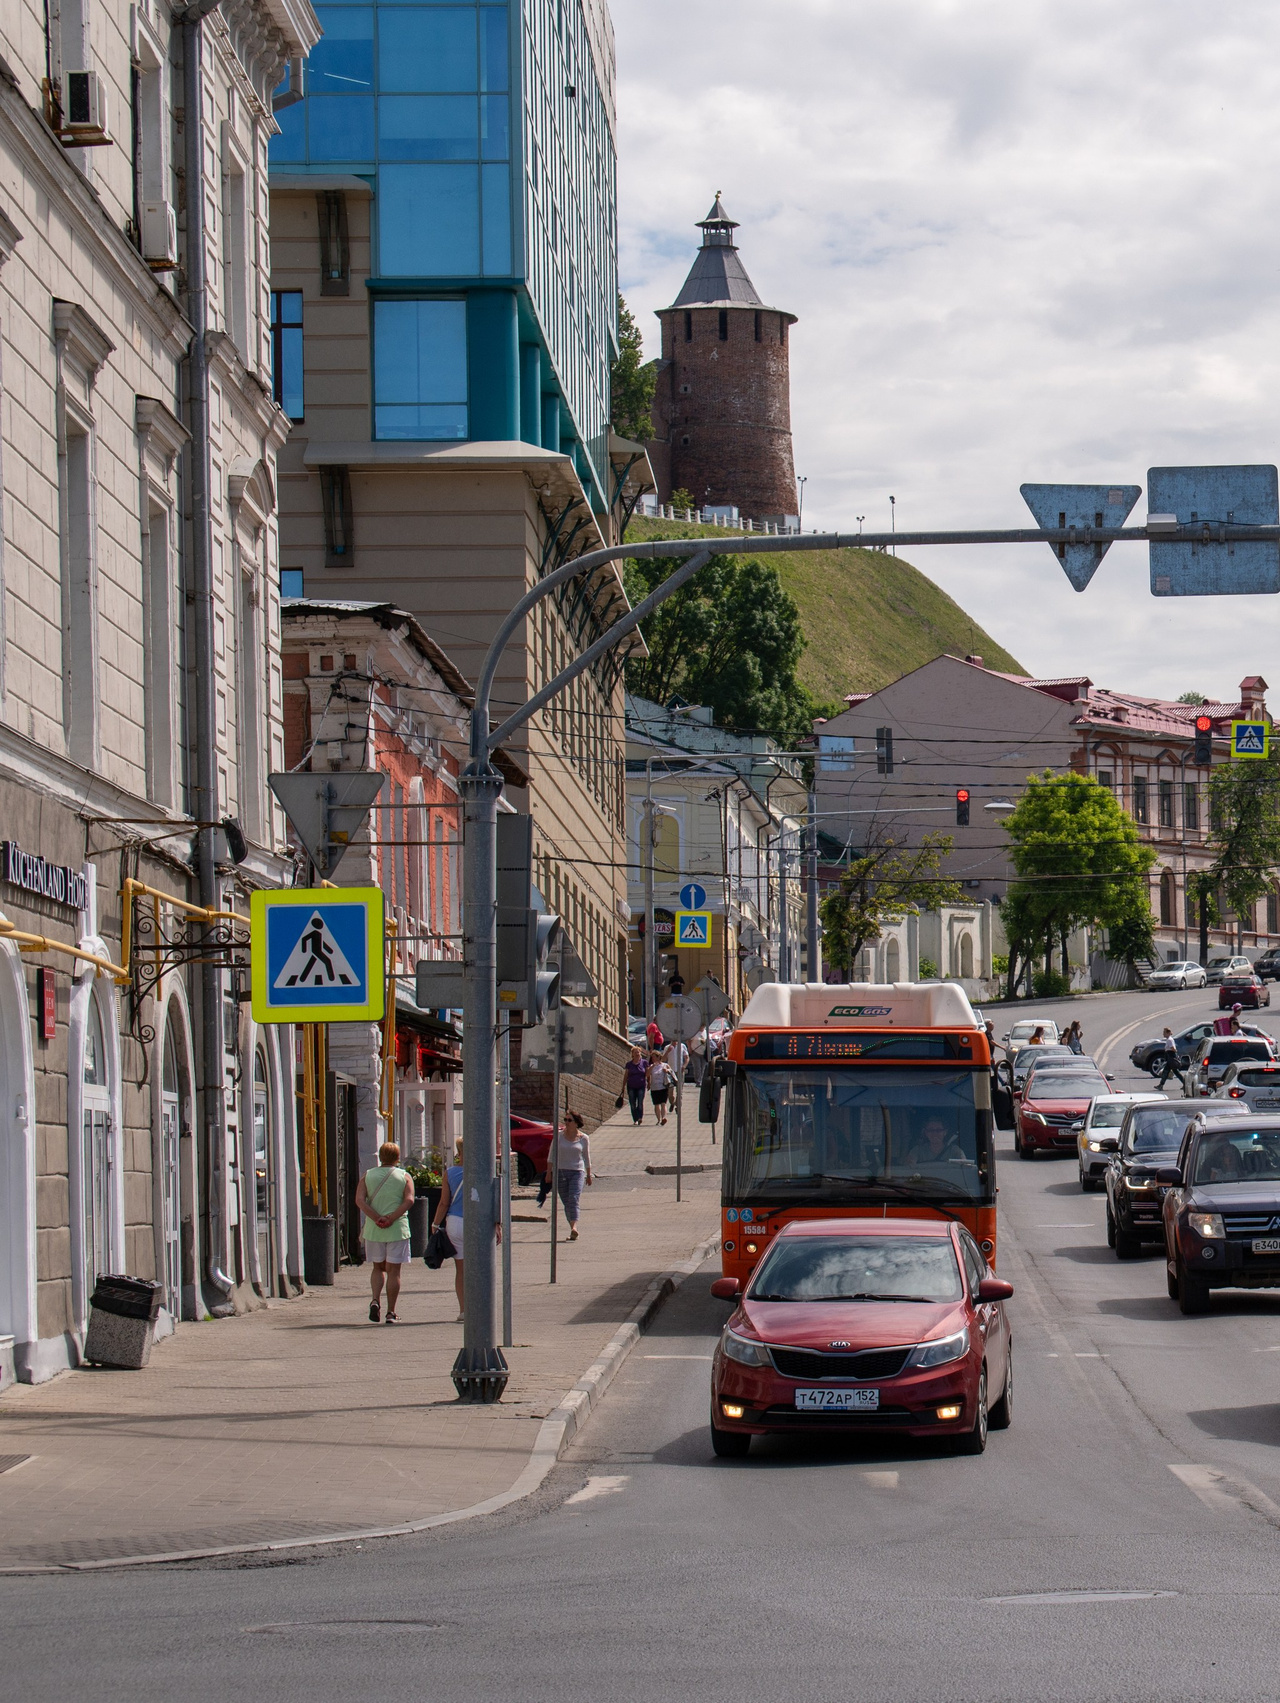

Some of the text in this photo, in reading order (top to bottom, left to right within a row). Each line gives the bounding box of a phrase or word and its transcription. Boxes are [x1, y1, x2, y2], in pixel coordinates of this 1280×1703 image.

[834, 1006, 891, 1016] ECO GAS
[744, 1225, 766, 1234] 15584
[800, 1390, 875, 1405] Т472АР 152
